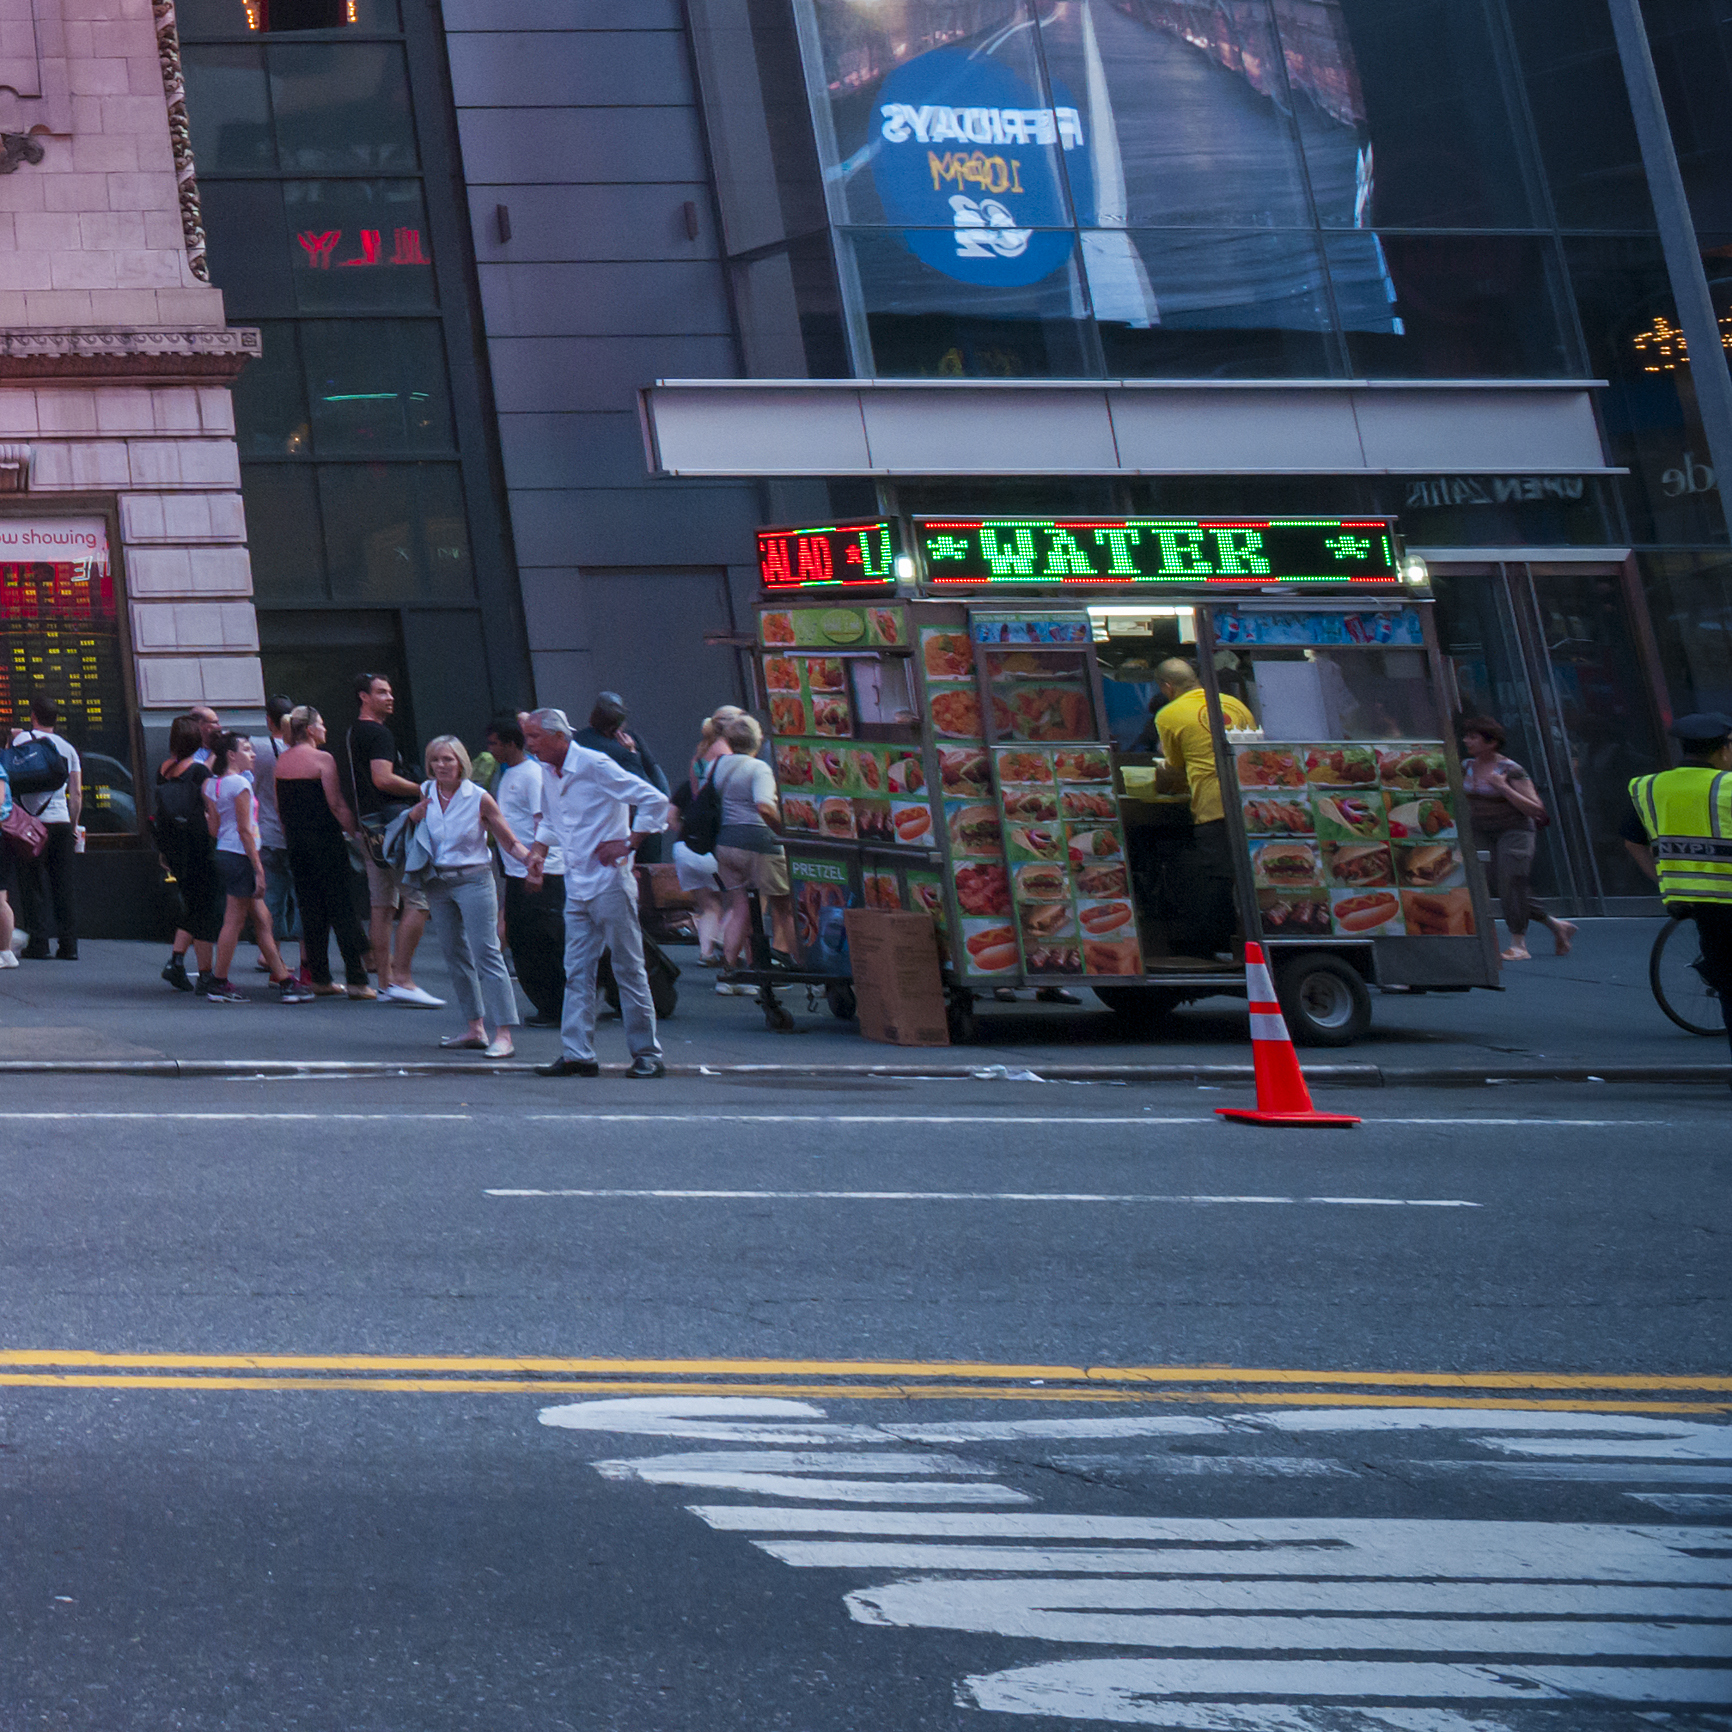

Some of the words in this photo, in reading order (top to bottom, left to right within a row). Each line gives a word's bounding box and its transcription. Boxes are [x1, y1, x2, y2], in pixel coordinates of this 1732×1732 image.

[22, 529, 98, 549] showing
[979, 527, 1271, 575] WATER
[1659, 841, 1717, 856] NYPD
[791, 861, 848, 881] PRETZEL
